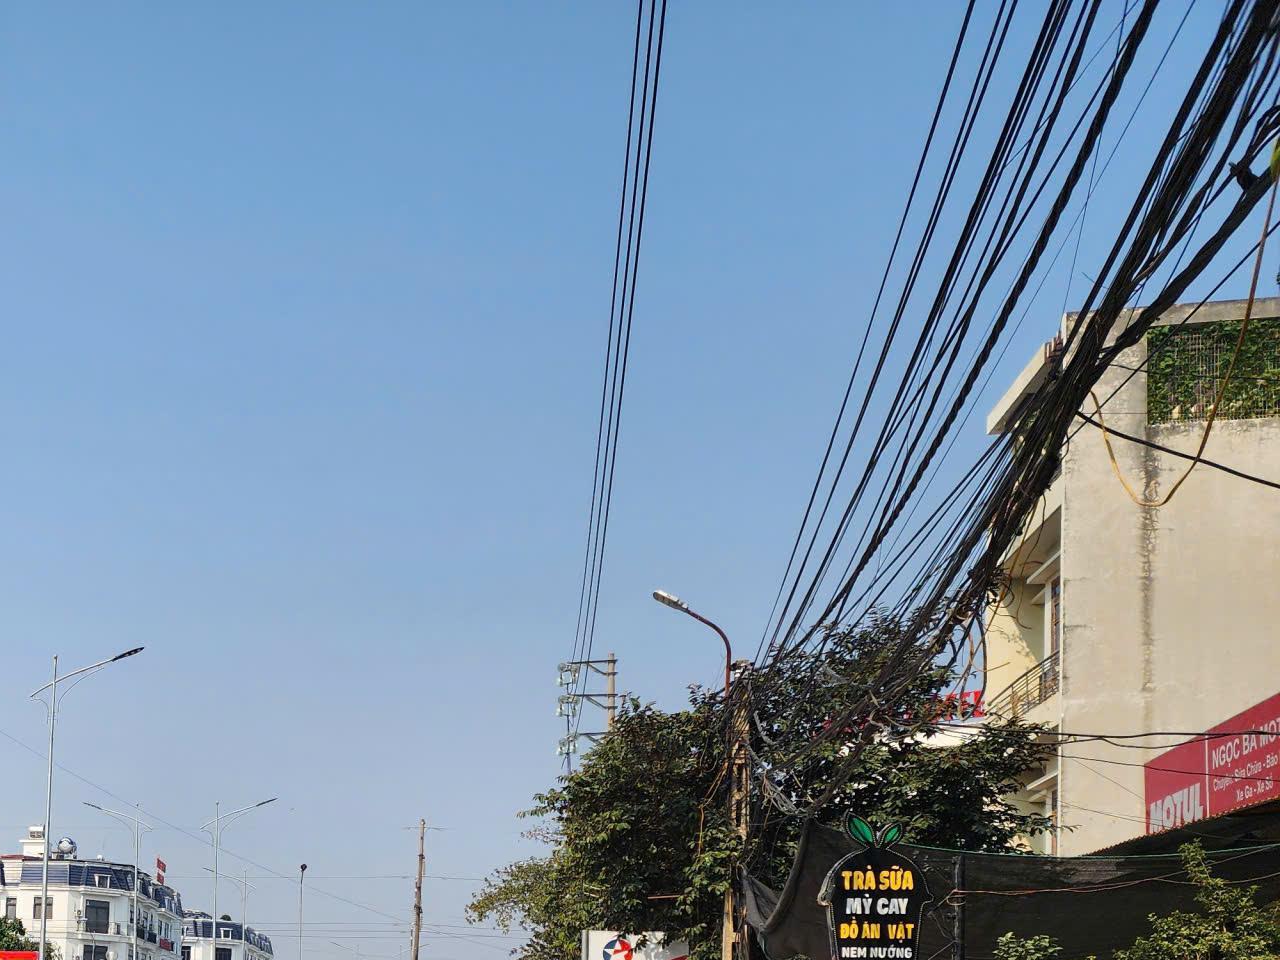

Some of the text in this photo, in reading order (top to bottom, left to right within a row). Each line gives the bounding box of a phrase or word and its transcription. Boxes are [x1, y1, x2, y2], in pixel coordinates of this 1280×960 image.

[1211, 738, 1240, 769] NGỌC
[1242, 724, 1258, 756] BÁ
[1149, 782, 1204, 834] MOTUL
[841, 865, 914, 890] TRÀ SỮA
[876, 897, 909, 915] CAY
[840, 916, 859, 939] ĐỒ
[841, 944, 913, 958] NEM NƯỚNG
